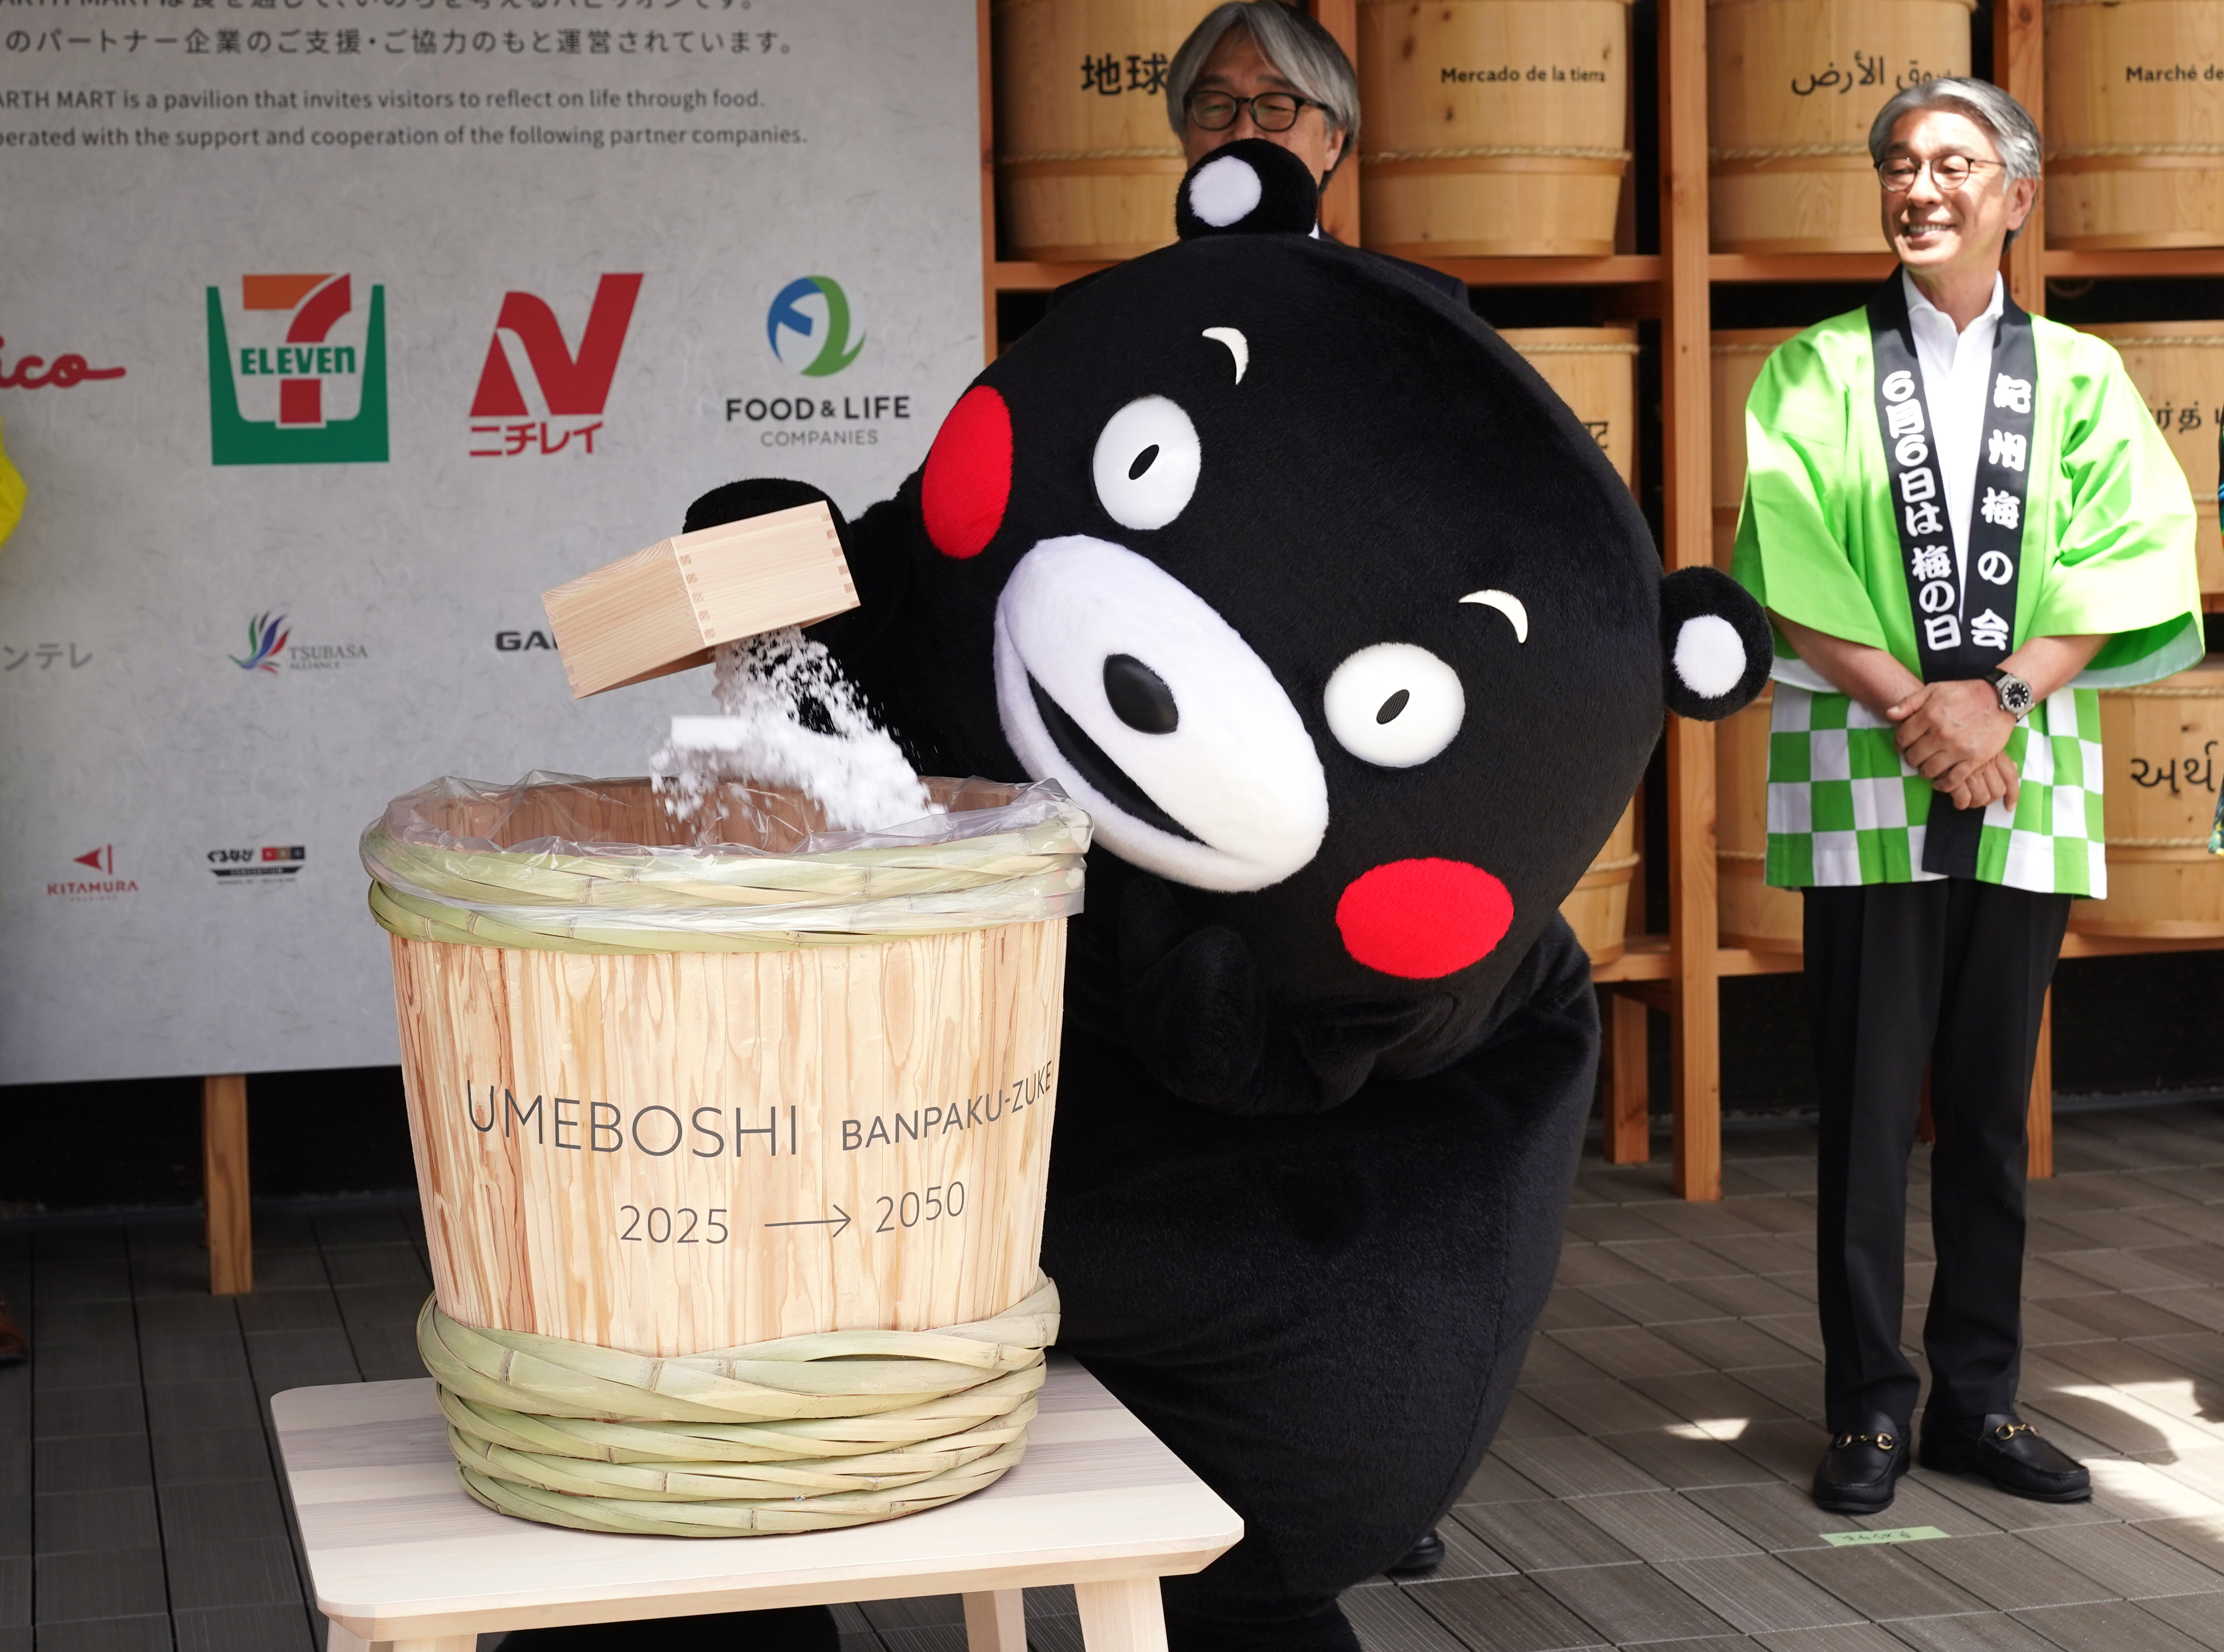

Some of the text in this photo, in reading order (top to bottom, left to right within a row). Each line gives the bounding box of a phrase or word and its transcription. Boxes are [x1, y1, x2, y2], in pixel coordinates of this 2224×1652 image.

[1440, 65, 1607, 84] Mercado de la tierra
[1791, 51, 1884, 96] الأرض
[2125, 64, 2224, 82] Marché de
[57, 91, 116, 108] MART
[124, 91, 140, 109] is
[146, 94, 158, 109] a
[164, 91, 249, 112] pavilion
[255, 90, 297, 109] that
[304, 91, 373, 109] invites
[379, 91, 455, 109] visitors
[460, 92, 481, 108] to
[486, 89, 552, 109] reflect
[558, 94, 584, 108] on
[590, 89, 622, 108] life
[627, 89, 707, 113] through
[713, 89, 765, 108] food.
[82, 128, 129, 146] with
[135, 127, 170, 147] the
[176, 129, 260, 150] support
[266, 127, 305, 146] and
[311, 128, 439, 149] cooperation
[445, 126, 465, 145] of
[471, 126, 504, 145] the
[510, 125, 605, 149] following
[611, 128, 687, 148] partner
[692, 127, 807, 147] companies.
[725, 395, 911, 422] FOOD & LIFE
[469, 421, 605, 458] ニチレイ
[760, 429, 879, 448] COMPANIES
[1882, 370, 1961, 651] 6月6日は梅の日
[288, 644, 368, 661] TSUBASA
[495, 630, 558, 653] GA
[47, 880, 139, 897] KITAMURA
[466, 1060, 1052, 1158] UMEBOSHI BANPAKU-ZUKE
[620, 1180, 966, 1245] 2025 2050
